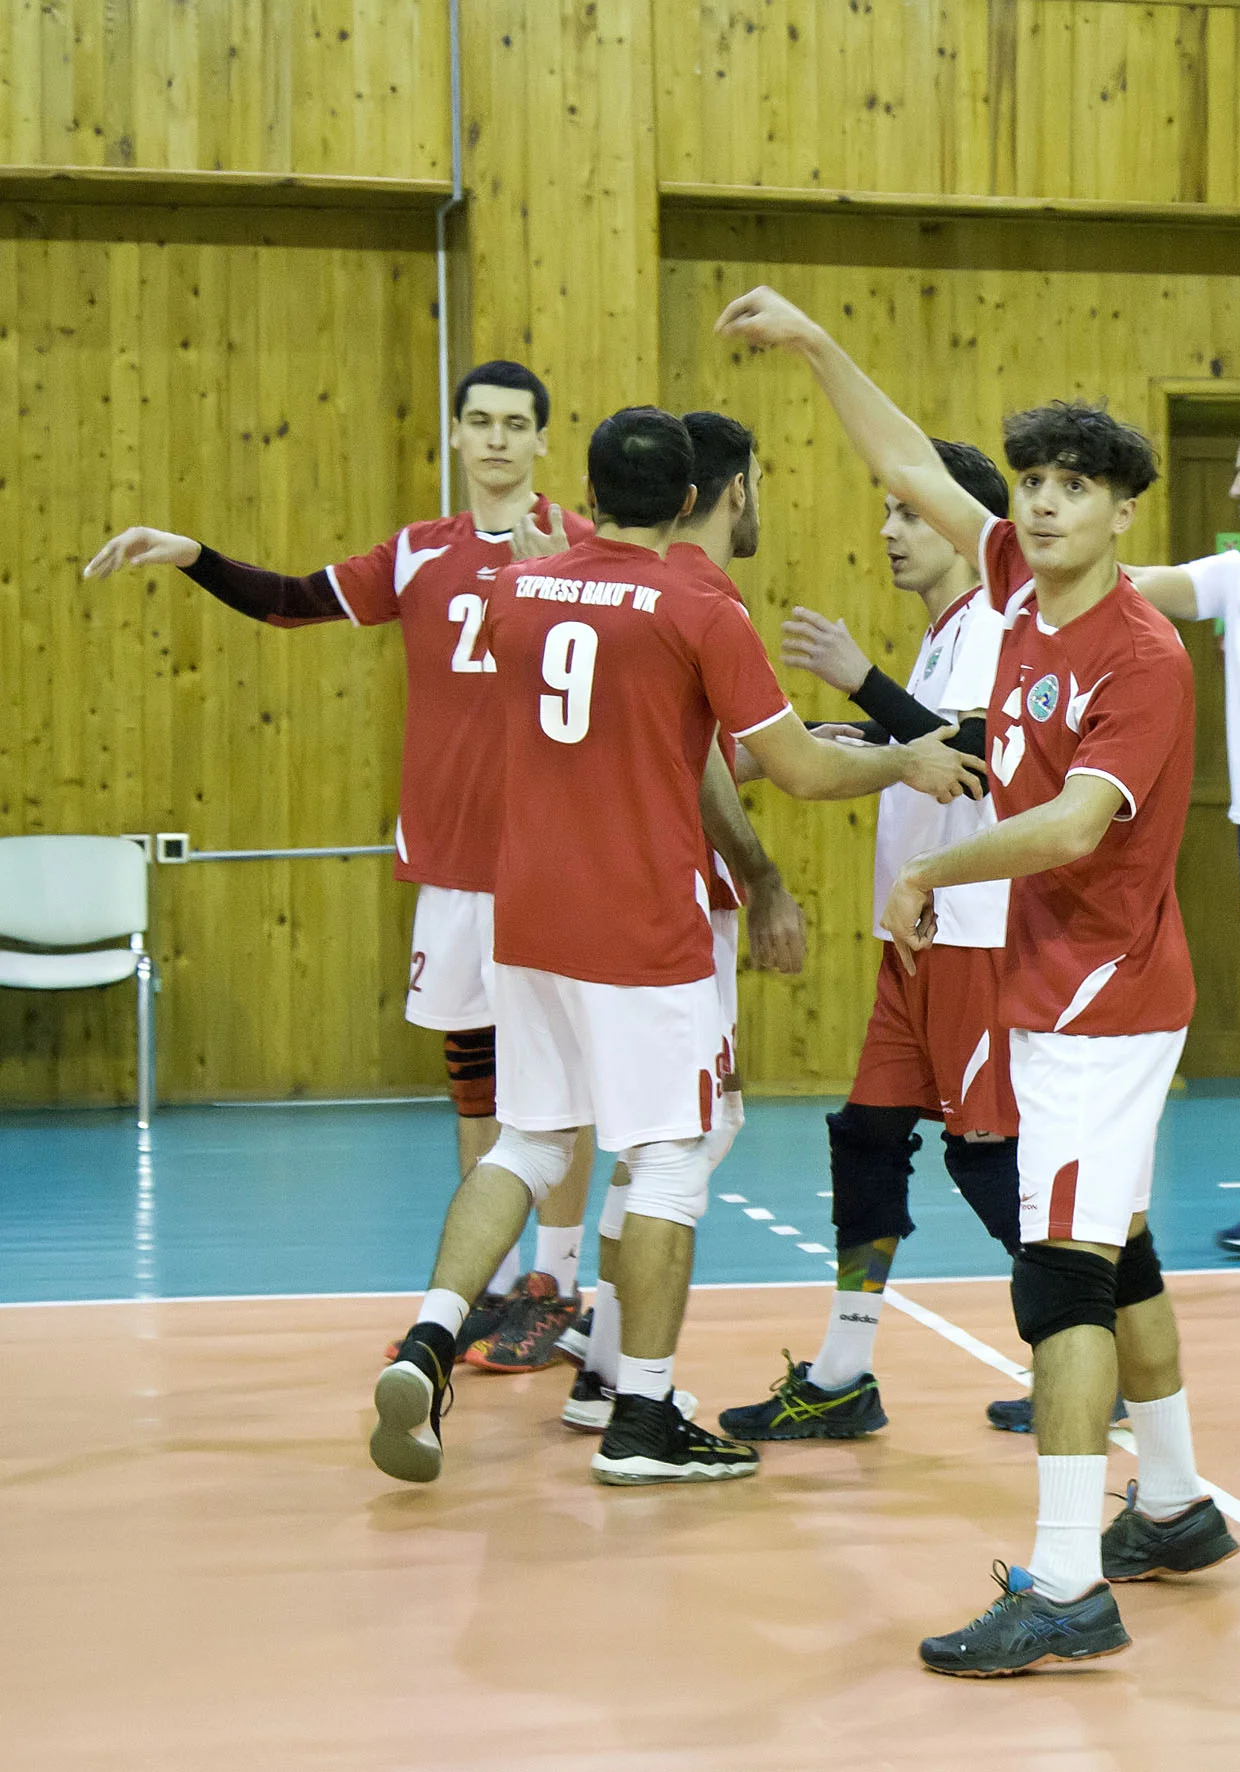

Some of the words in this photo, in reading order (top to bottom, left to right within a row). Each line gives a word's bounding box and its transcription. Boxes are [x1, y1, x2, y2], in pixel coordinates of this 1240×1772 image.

[632, 585, 662, 614] VK
[540, 621, 599, 744] 9
[410, 951, 426, 992] 2
